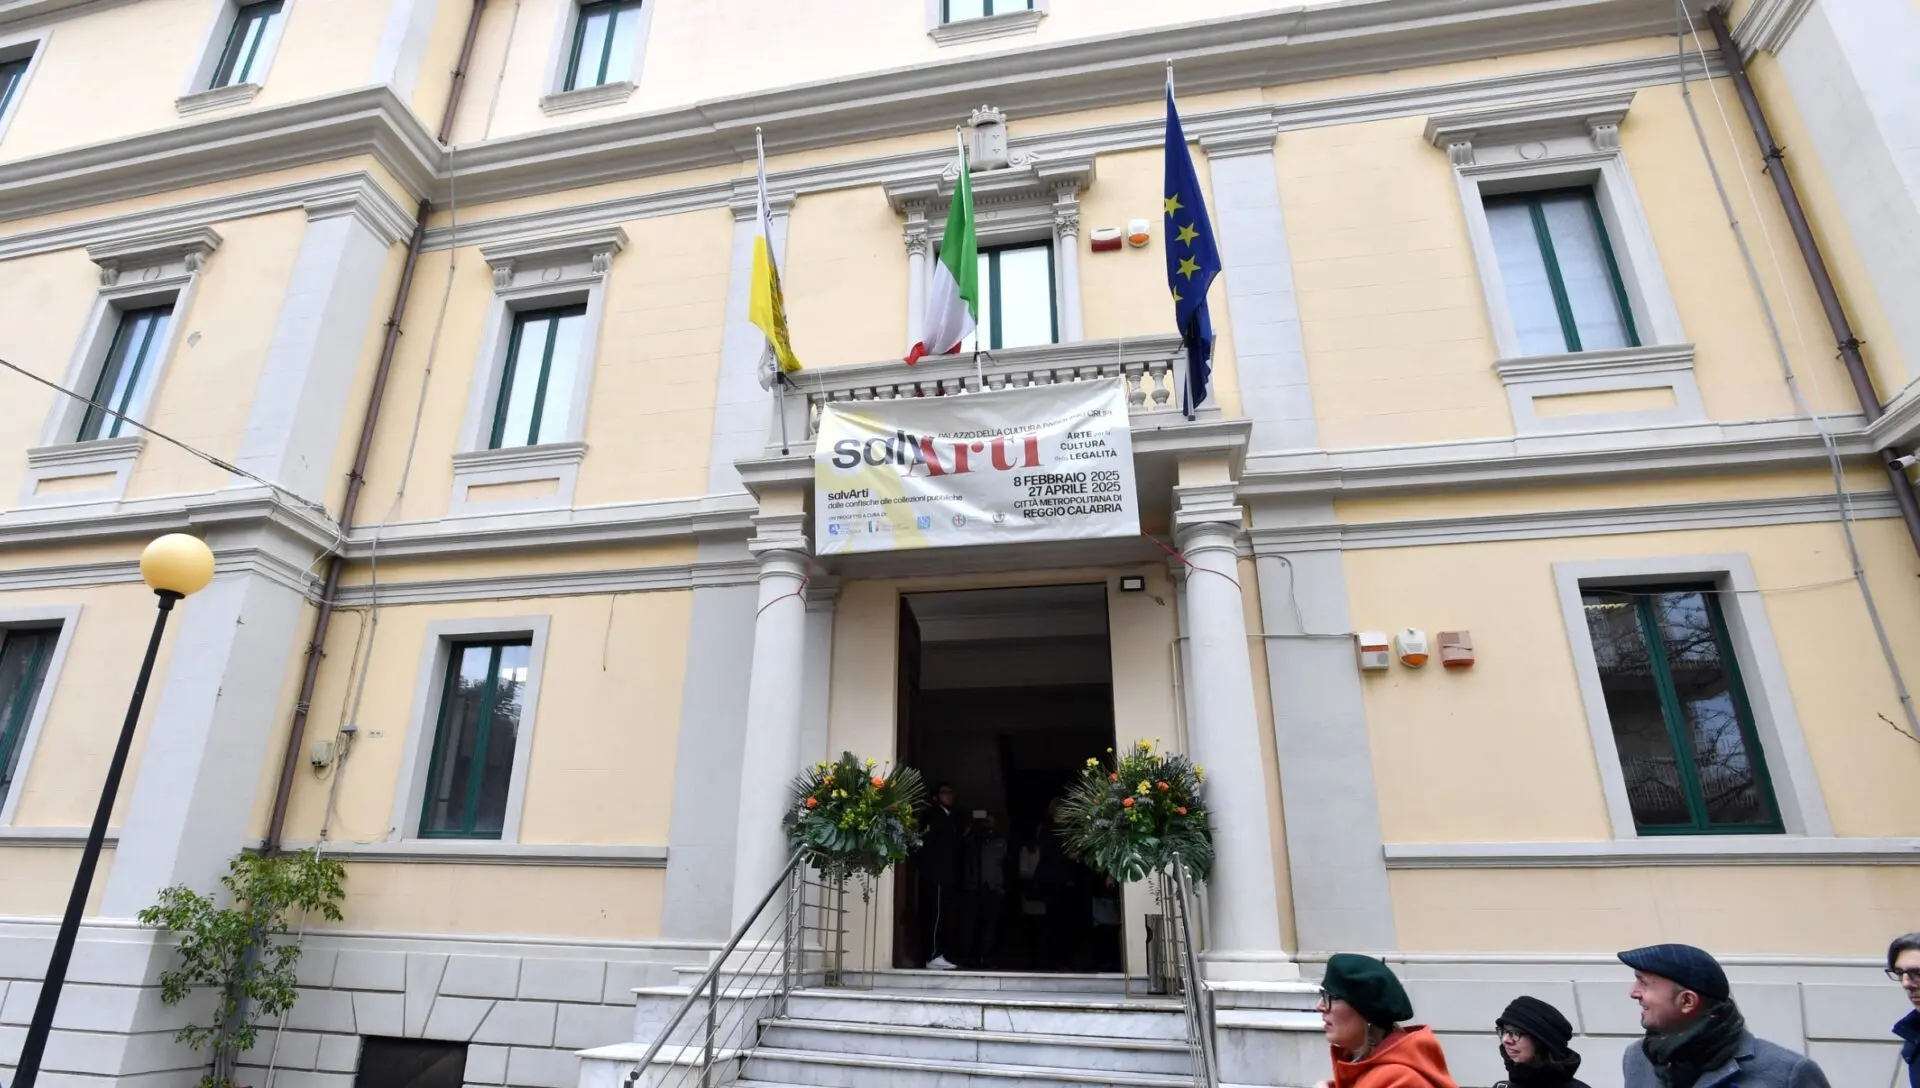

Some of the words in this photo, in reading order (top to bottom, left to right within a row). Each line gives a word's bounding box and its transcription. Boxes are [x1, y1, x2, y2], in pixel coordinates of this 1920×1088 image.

[938, 431, 975, 439] PALAZZO
[976, 428, 1003, 438] DELLA
[1003, 424, 1041, 435] CULTURA
[1067, 430, 1093, 440] ARTE
[1060, 439, 1106, 451] CULTURA
[1070, 449, 1117, 461] LEGALITÀ
[1014, 476, 1022, 487] 8
[1024, 472, 1086, 486] FEBBRAIO
[1090, 470, 1120, 482] 2025
[828, 488, 869, 500] salvArti
[1028, 486, 1042, 497] 27
[1045, 483, 1088, 496] APRILE
[1091, 481, 1121, 493] 2025
[828, 500, 844, 509] dalle
[845, 499, 879, 508] confische
[893, 495, 926, 504] collezioni
[1013, 498, 1038, 509] CITTÀ
[1039, 494, 1112, 506] METROPOLITANA
[1113, 494, 1122, 502] DI
[1023, 507, 1065, 518] REGGIO
[1066, 503, 1122, 515] CALABRIA
